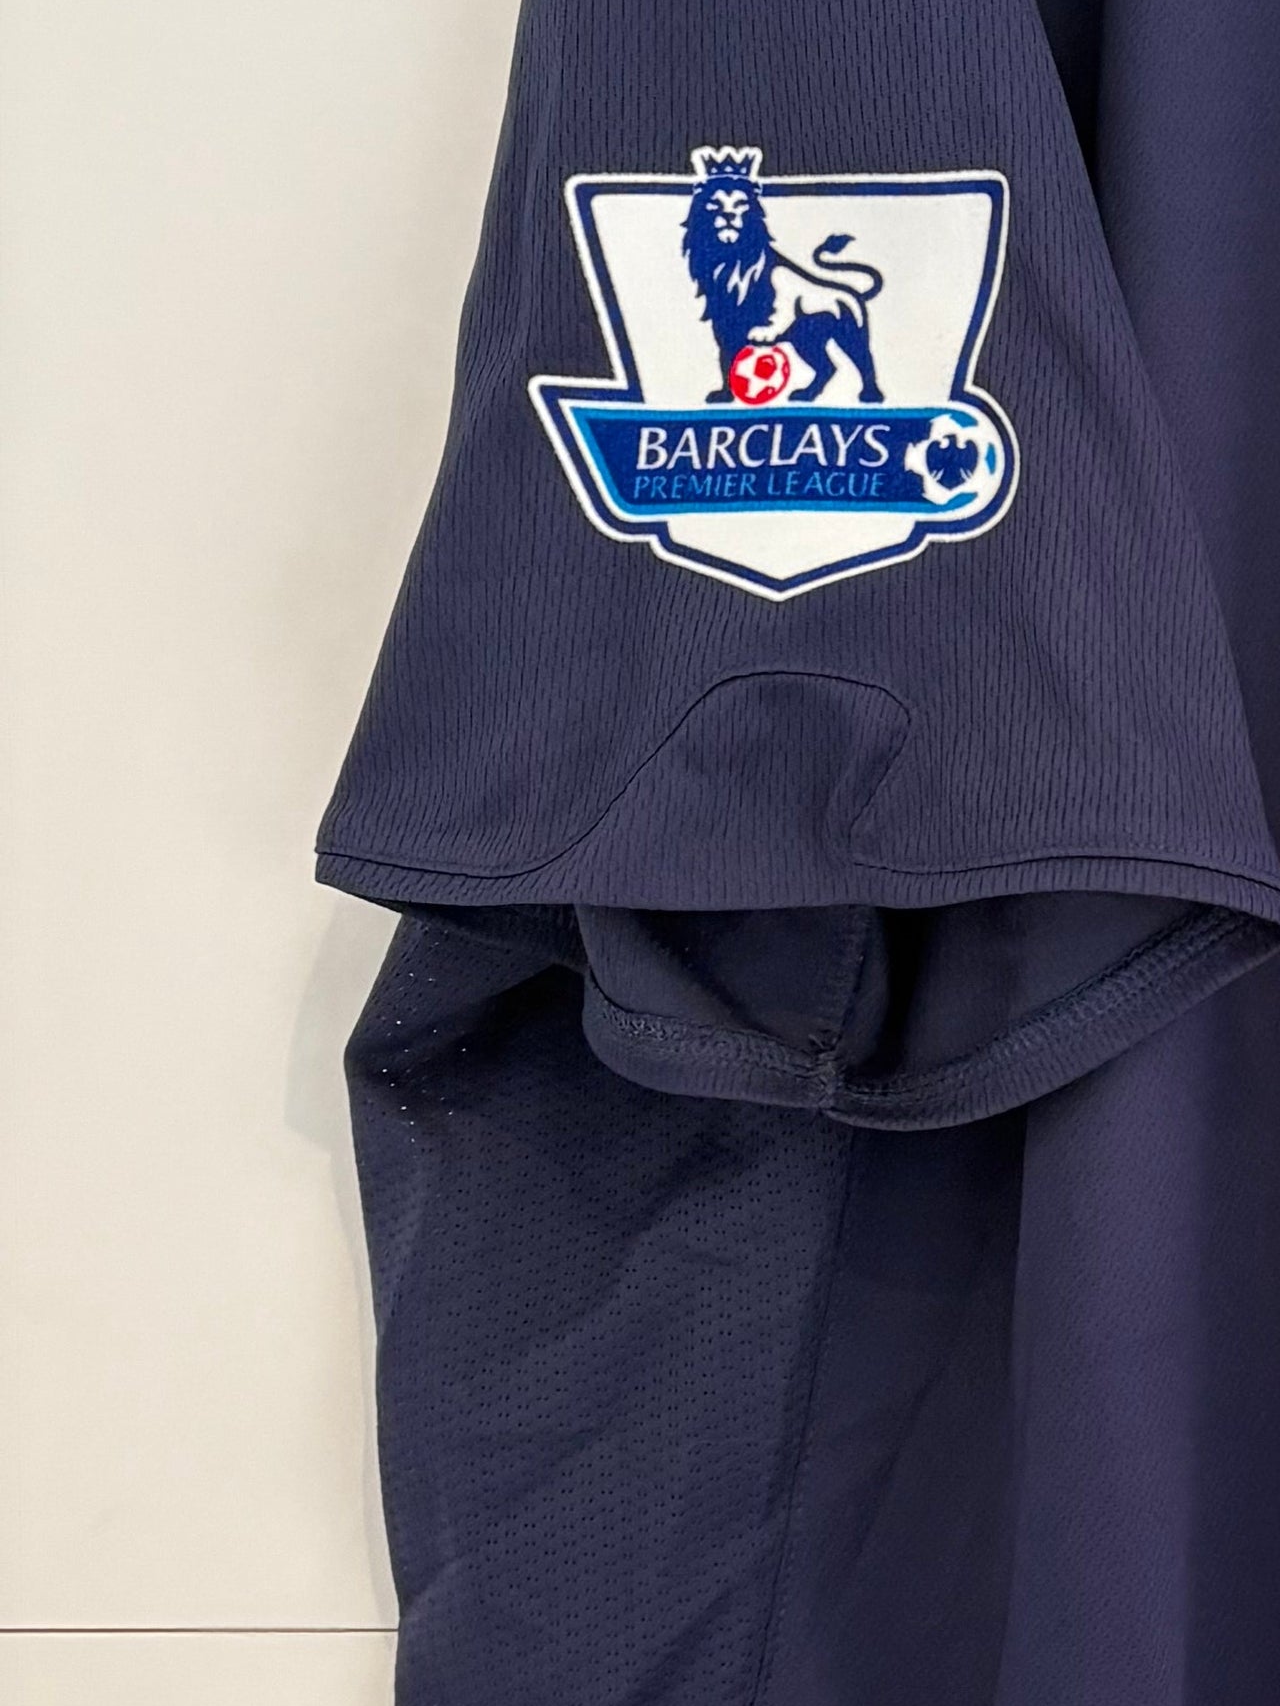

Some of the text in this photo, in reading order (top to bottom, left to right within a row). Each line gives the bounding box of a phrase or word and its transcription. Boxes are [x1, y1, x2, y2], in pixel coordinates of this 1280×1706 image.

[635, 424, 890, 470] BARCLAYS
[634, 471, 886, 499] PREMIER LEAGUE
